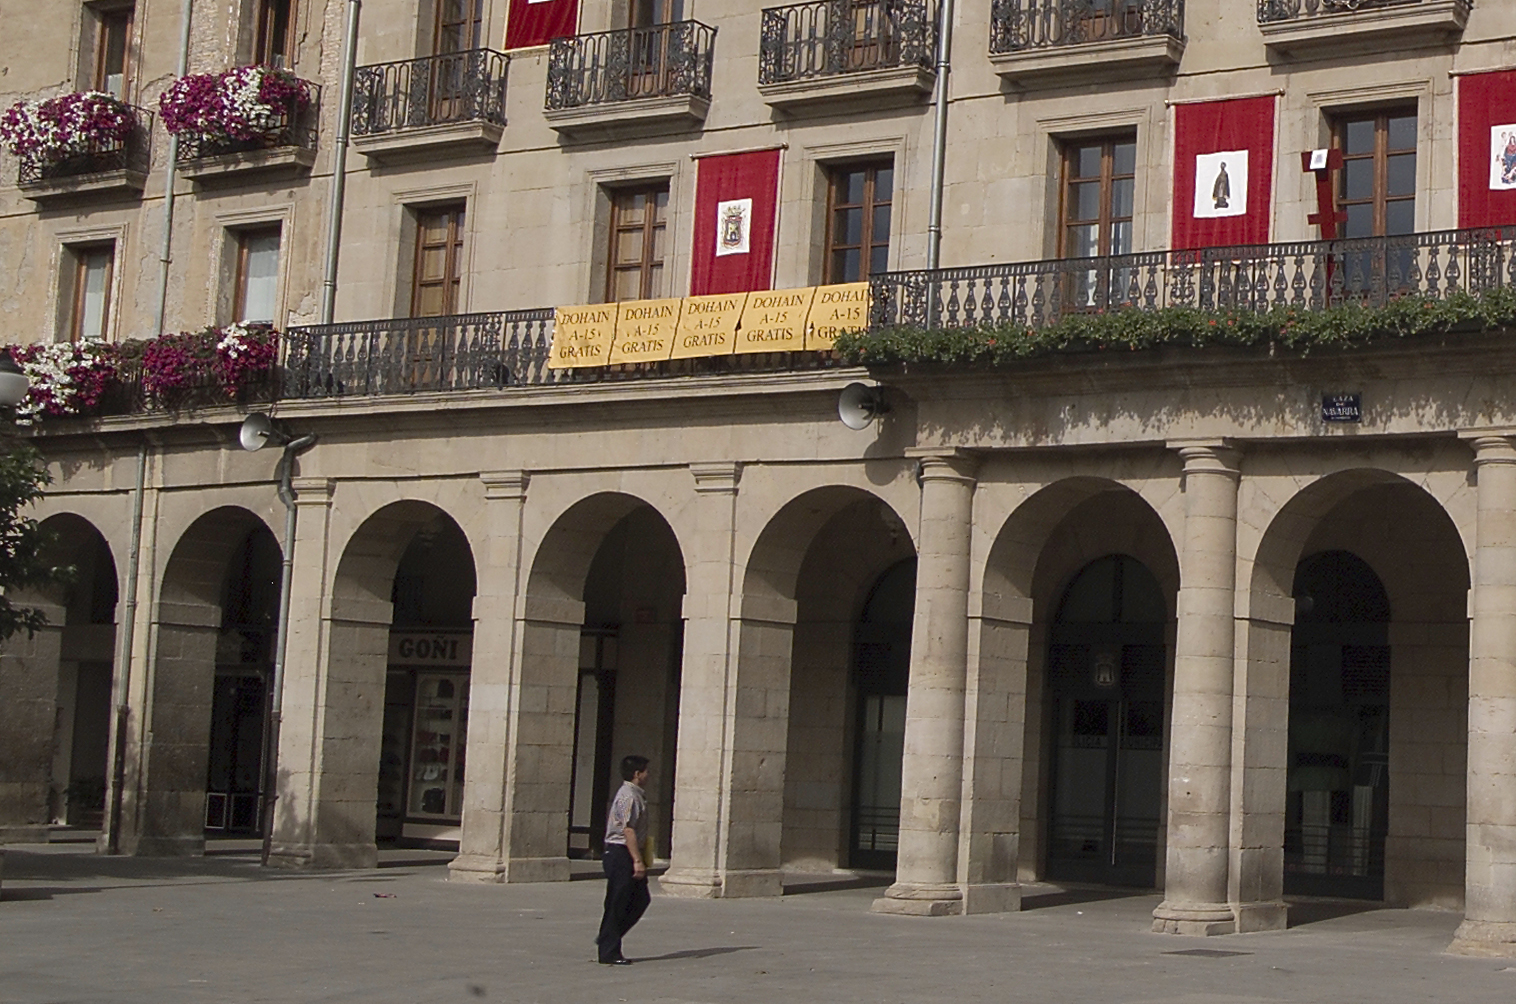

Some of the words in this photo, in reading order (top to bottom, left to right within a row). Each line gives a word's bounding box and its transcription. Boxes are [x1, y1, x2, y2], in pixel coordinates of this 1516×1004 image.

[687, 299, 739, 314] DOHAIN
[753, 294, 805, 309] DOHAIN
[560, 310, 610, 325] DOHAIN
[625, 305, 674, 321] DOHAIN
[759, 311, 788, 324] A-15
[830, 308, 860, 320] A-15
[634, 323, 659, 336] A-15
[694, 317, 722, 330] A-15
[569, 328, 596, 341] A-15
[683, 333, 726, 348] GRATIS
[746, 328, 793, 342] GRATIS
[559, 344, 601, 358] GRATIS
[621, 339, 664, 354] GRATIS
[398, 635, 458, 660] GOÑI
